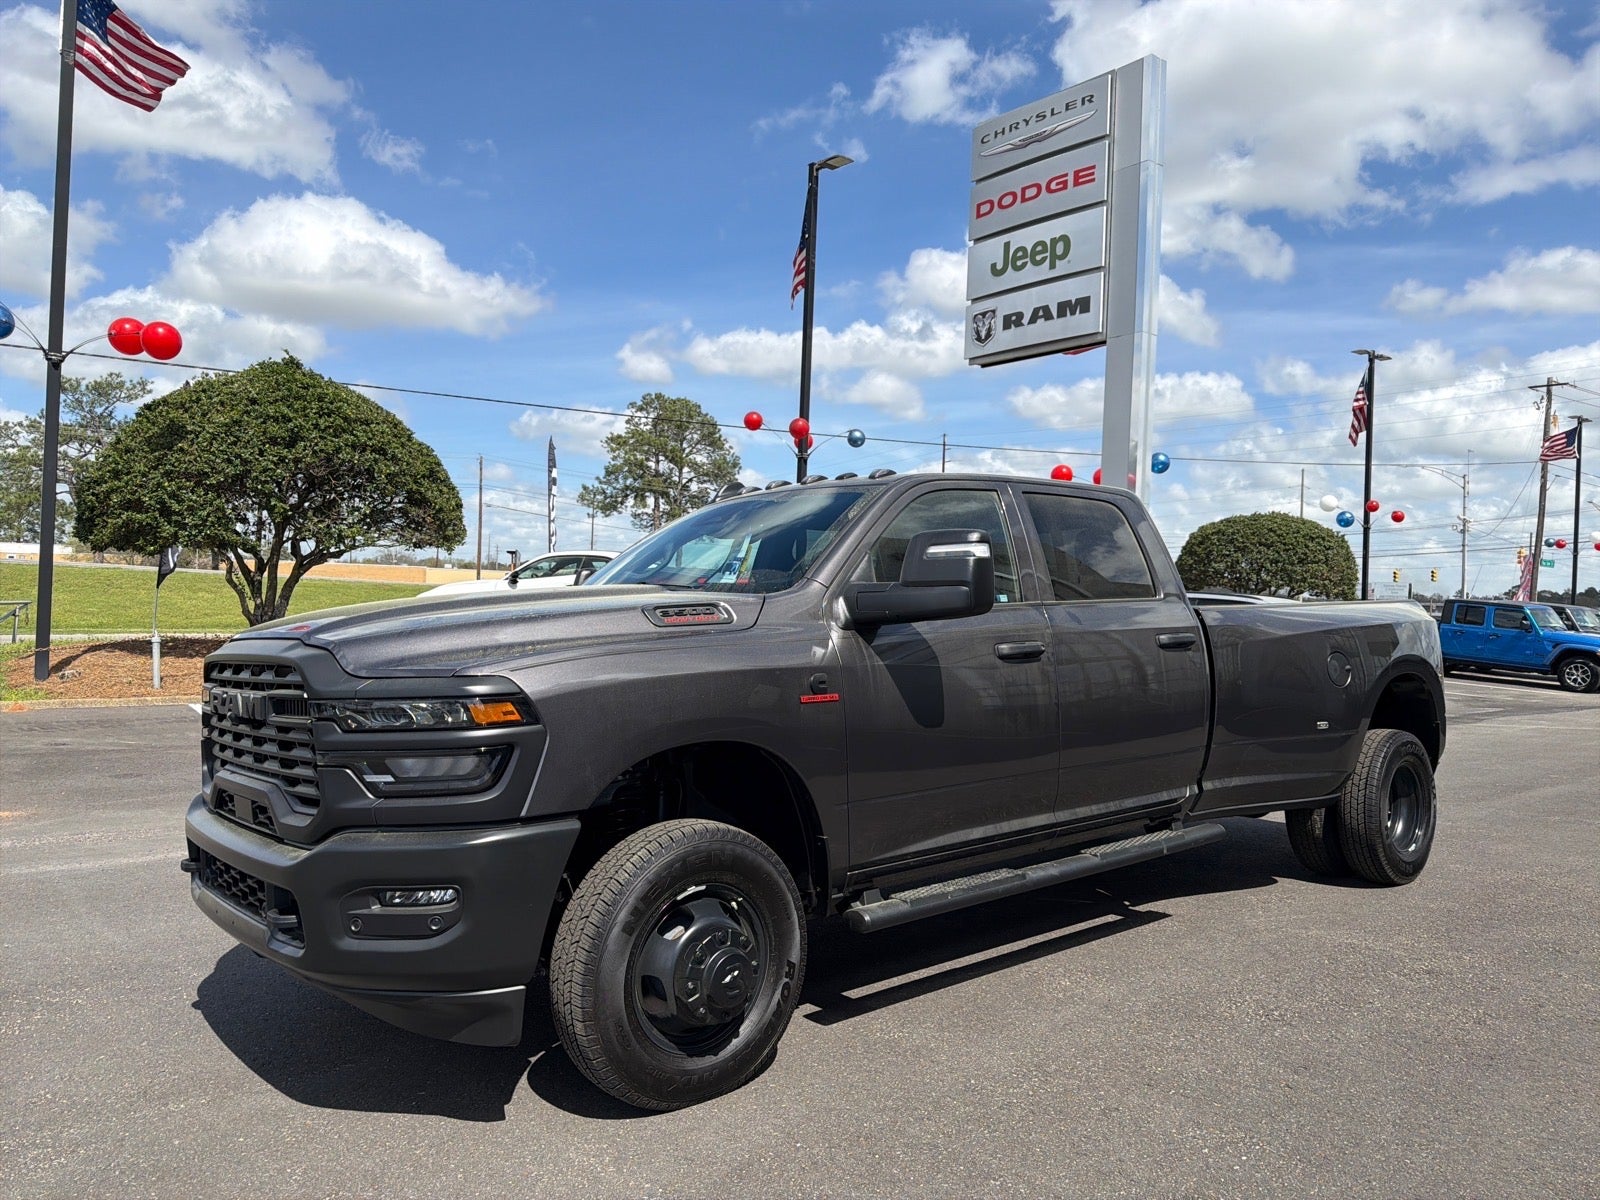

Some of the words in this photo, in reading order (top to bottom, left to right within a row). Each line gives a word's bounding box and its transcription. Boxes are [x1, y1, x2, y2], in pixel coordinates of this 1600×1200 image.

[981, 94, 1095, 144] CHRYSLER
[976, 165, 1096, 220] DODGE
[990, 233, 1071, 277] Jeep
[1003, 295, 1091, 331] RAM
[659, 608, 715, 617] 3500
[210, 691, 264, 720] RAM
